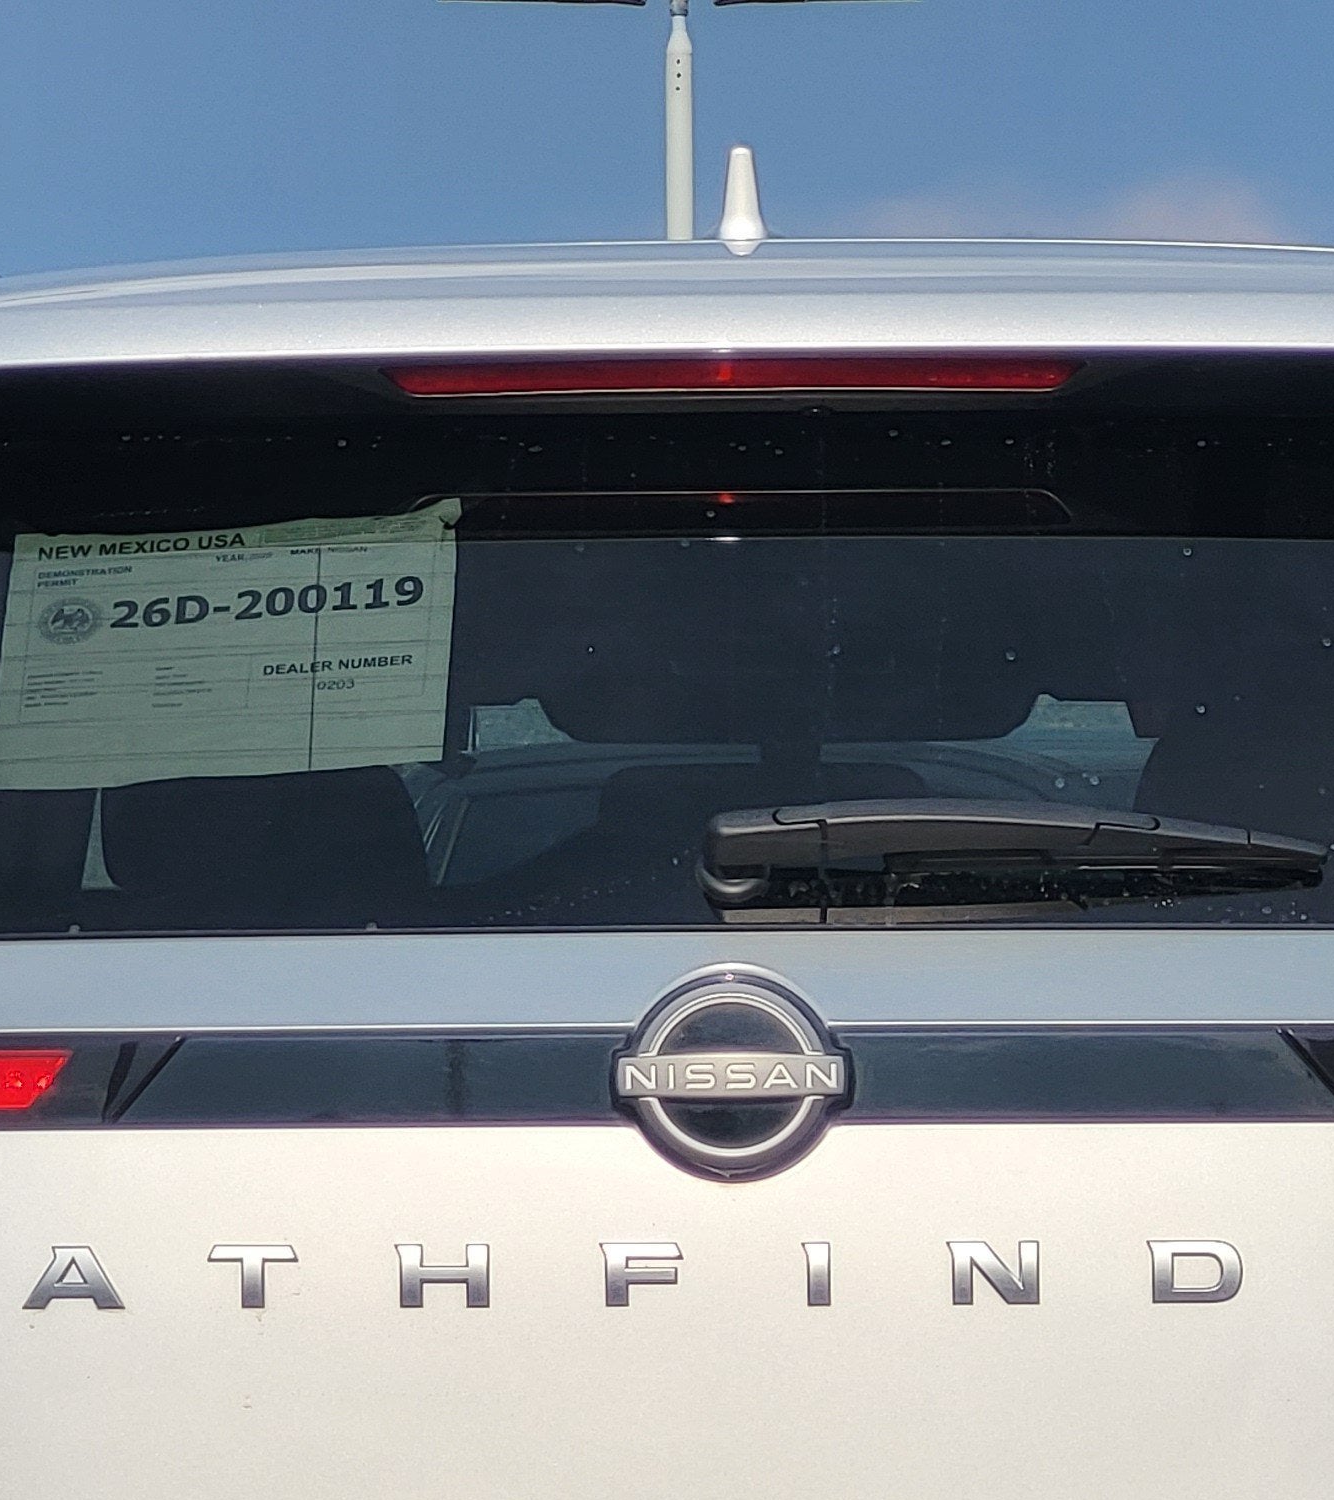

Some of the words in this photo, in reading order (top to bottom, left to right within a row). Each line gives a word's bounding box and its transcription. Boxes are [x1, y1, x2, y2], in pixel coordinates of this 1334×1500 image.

[38, 544, 92, 561] NEW
[99, 537, 189, 556] MEXICO
[198, 533, 245, 550] USA
[216, 553, 245, 563] YEAR
[38, 565, 133, 579] DEMONSTRATION
[37, 578, 79, 588] PERMIT
[109, 575, 424, 628] 26D-200119
[263, 660, 332, 676] DEALER
[338, 654, 413, 670] NUMBER
[317, 679, 356, 691] 0203
[624, 1062, 839, 1090] NISSAN
